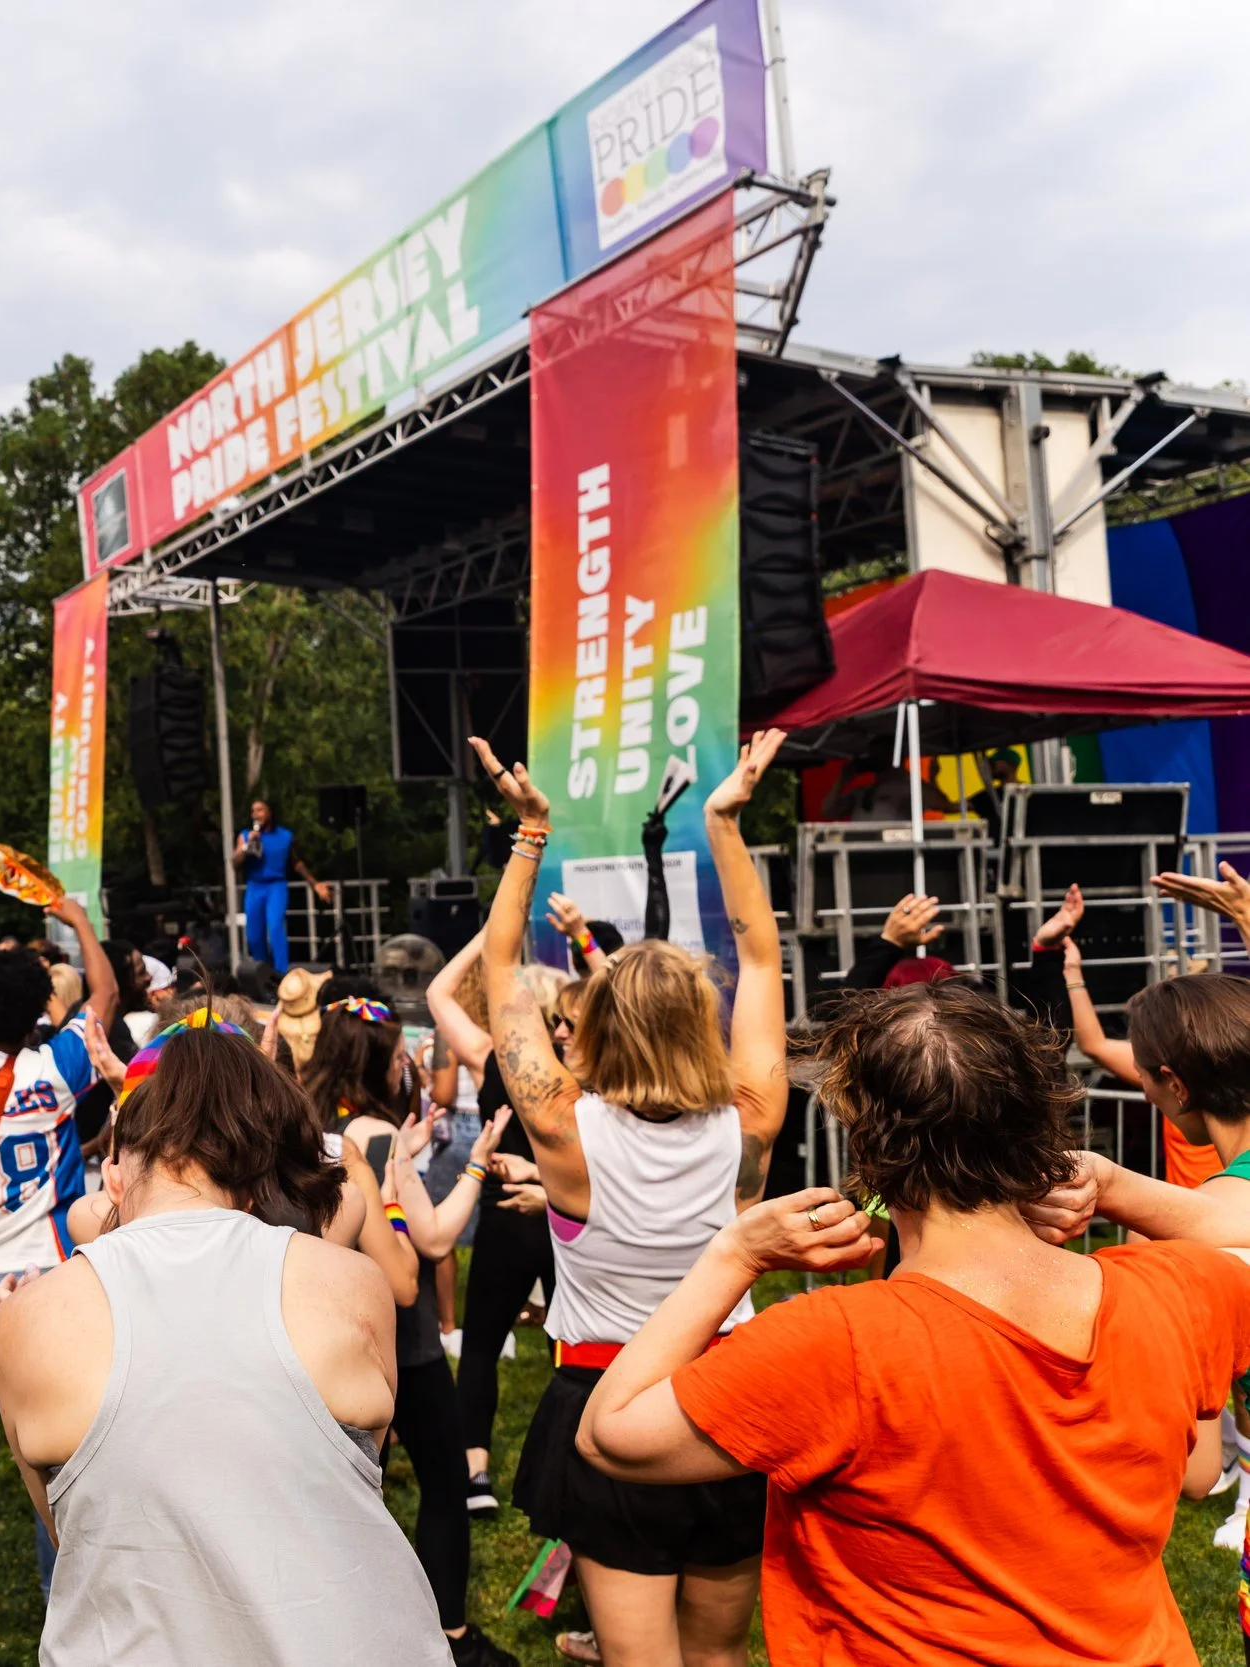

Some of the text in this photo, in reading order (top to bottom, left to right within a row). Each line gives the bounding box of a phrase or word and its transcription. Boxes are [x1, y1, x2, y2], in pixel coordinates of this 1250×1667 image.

[594, 58, 721, 185] PRIDE
[166, 195, 468, 471] NORTH JERSEY
[170, 280, 480, 522] PRIDE FESTIVAL
[566, 462, 612, 800] STRENGTH
[614, 594, 655, 796] UNITY
[665, 604, 709, 784] LOVE
[49, 692, 68, 864] EQUALITY
[75, 636, 96, 860] COMMUNITY
